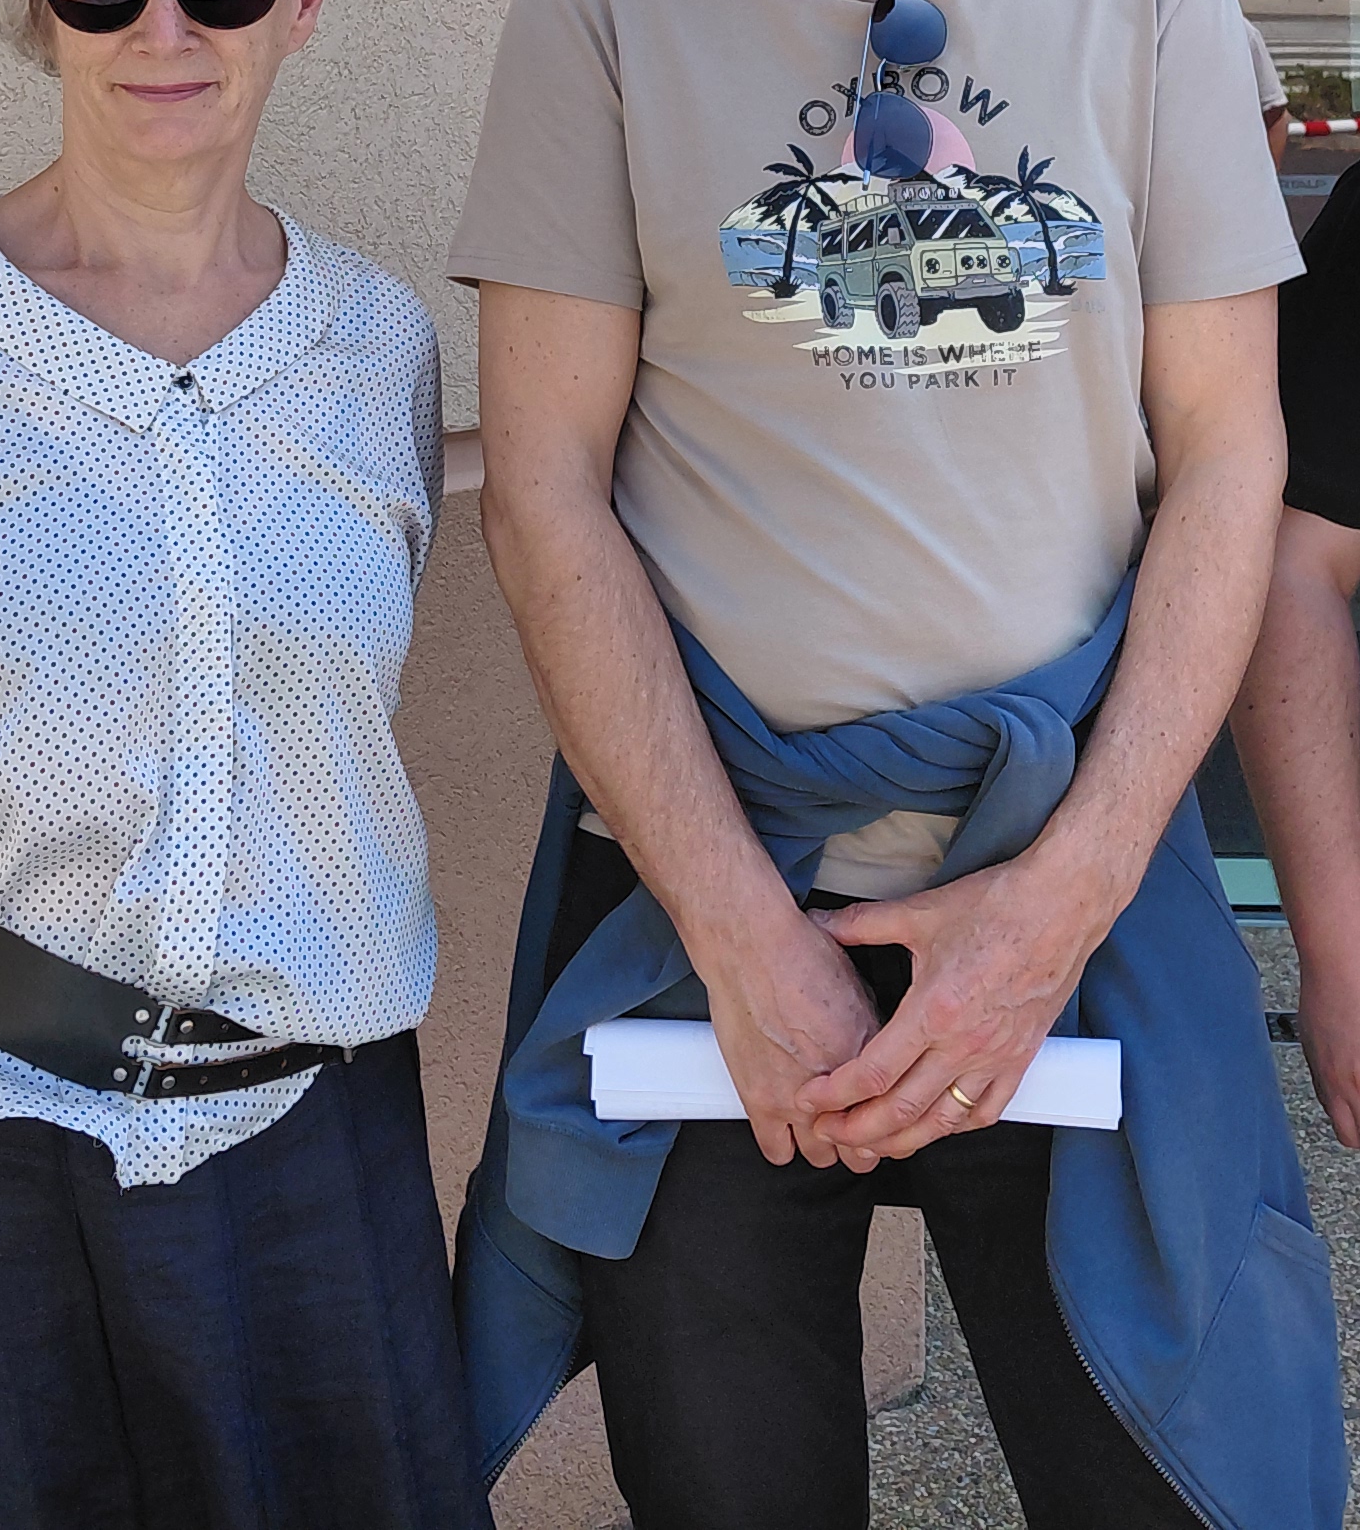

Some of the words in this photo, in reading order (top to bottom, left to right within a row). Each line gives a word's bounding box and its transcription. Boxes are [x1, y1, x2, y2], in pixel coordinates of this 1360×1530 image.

[799, 67, 1009, 136] OXBOW
[813, 346, 895, 367] HOME
[904, 345, 927, 366] IS
[840, 372, 895, 390] YOU
[908, 369, 980, 389] PARK
[993, 368, 1016, 386] IT
